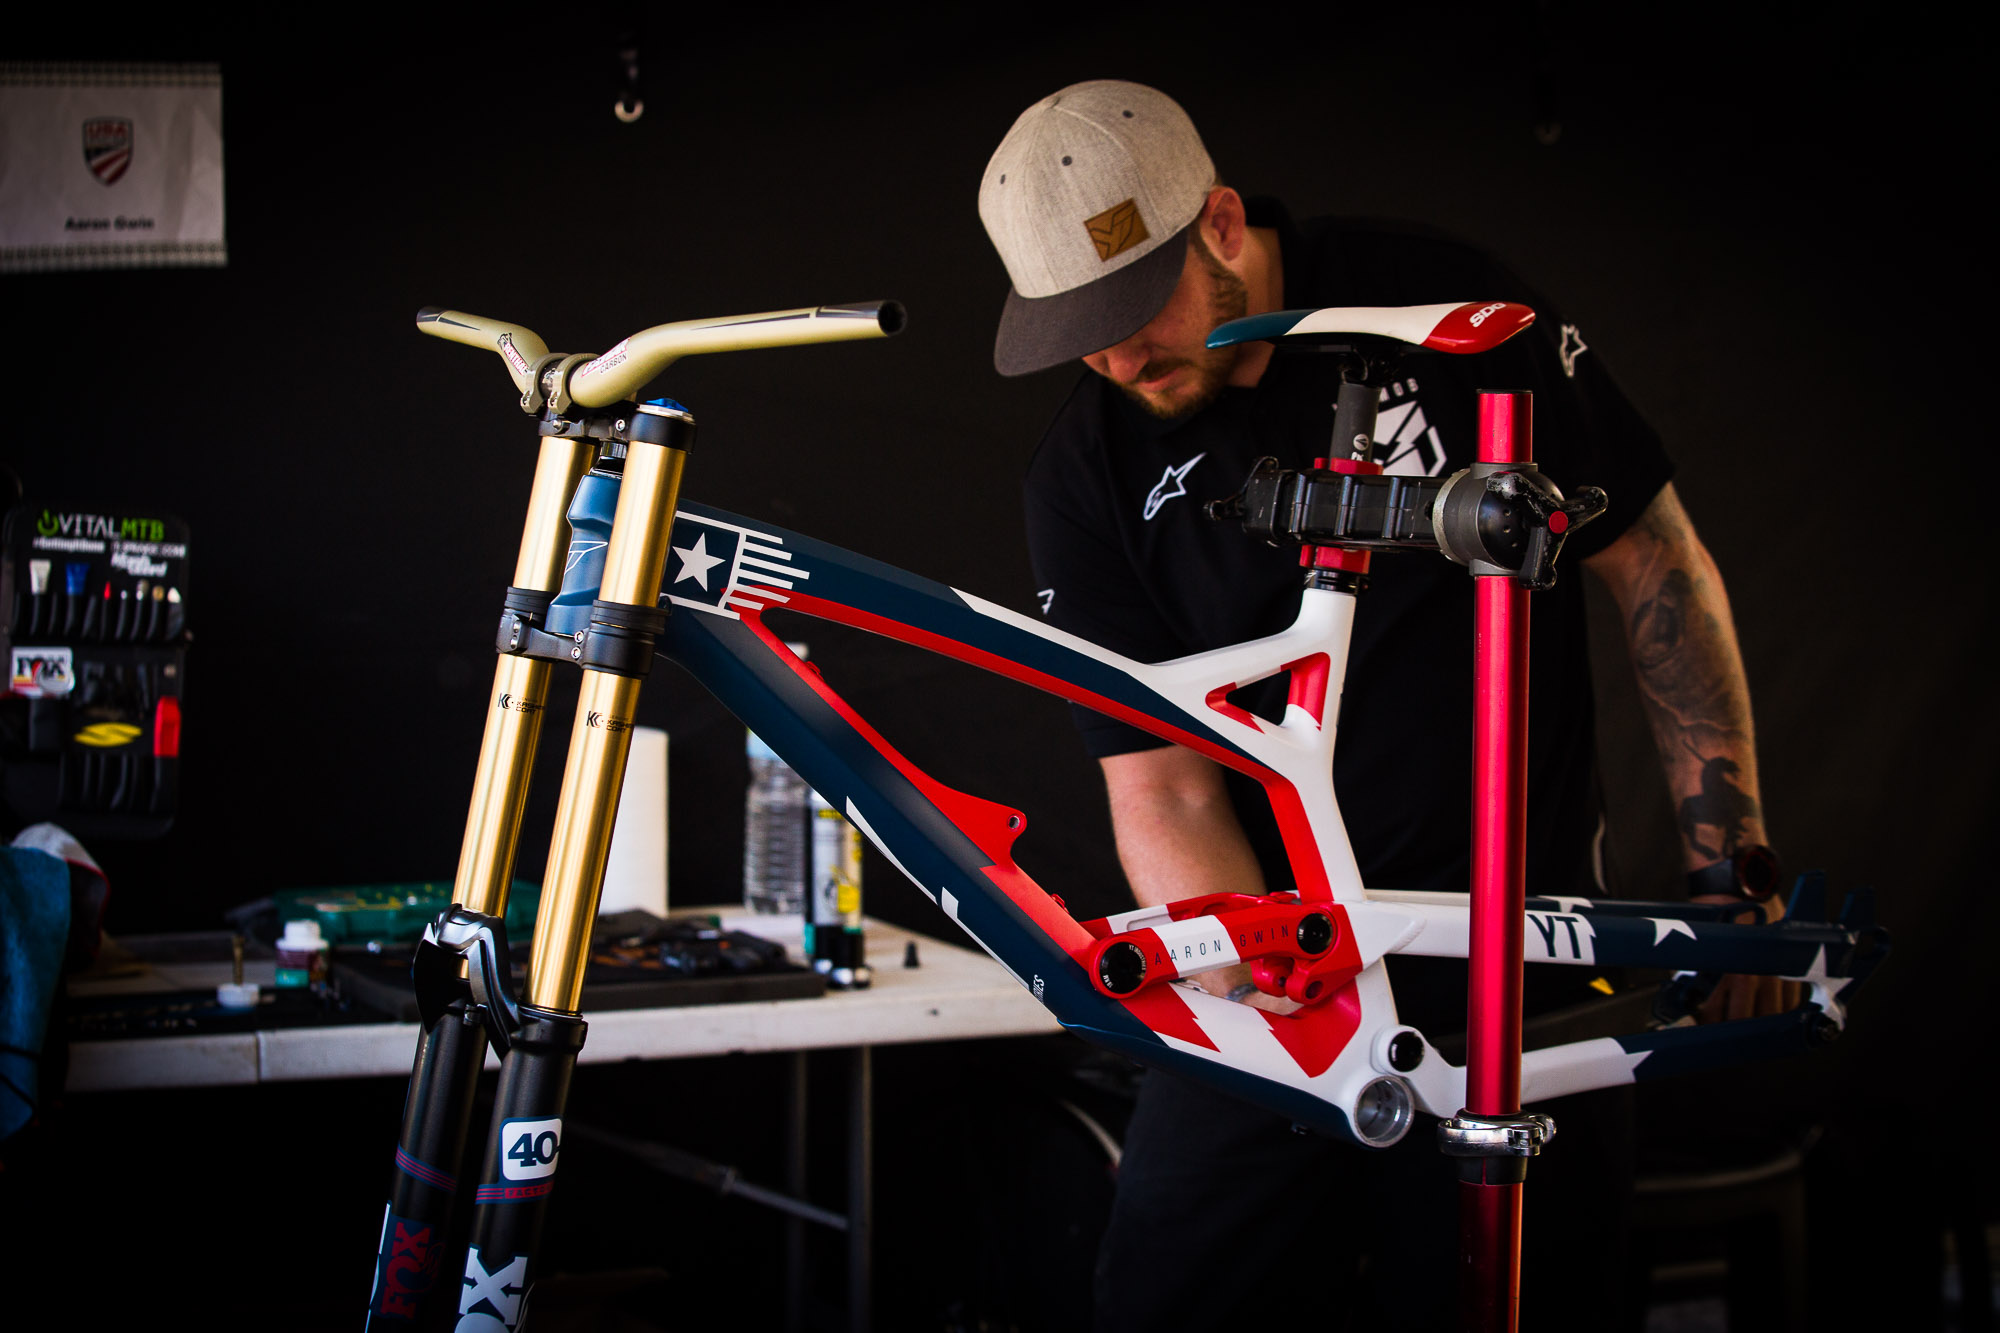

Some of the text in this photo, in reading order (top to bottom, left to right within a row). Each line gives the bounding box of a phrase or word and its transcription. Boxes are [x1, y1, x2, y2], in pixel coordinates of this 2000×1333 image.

[1154, 938, 1222, 966] AARON
[1239, 925, 1289, 948] GWIN
[1526, 914, 1581, 959] YT
[507, 1130, 560, 1168] 40
[380, 1221, 433, 1320] FOX
